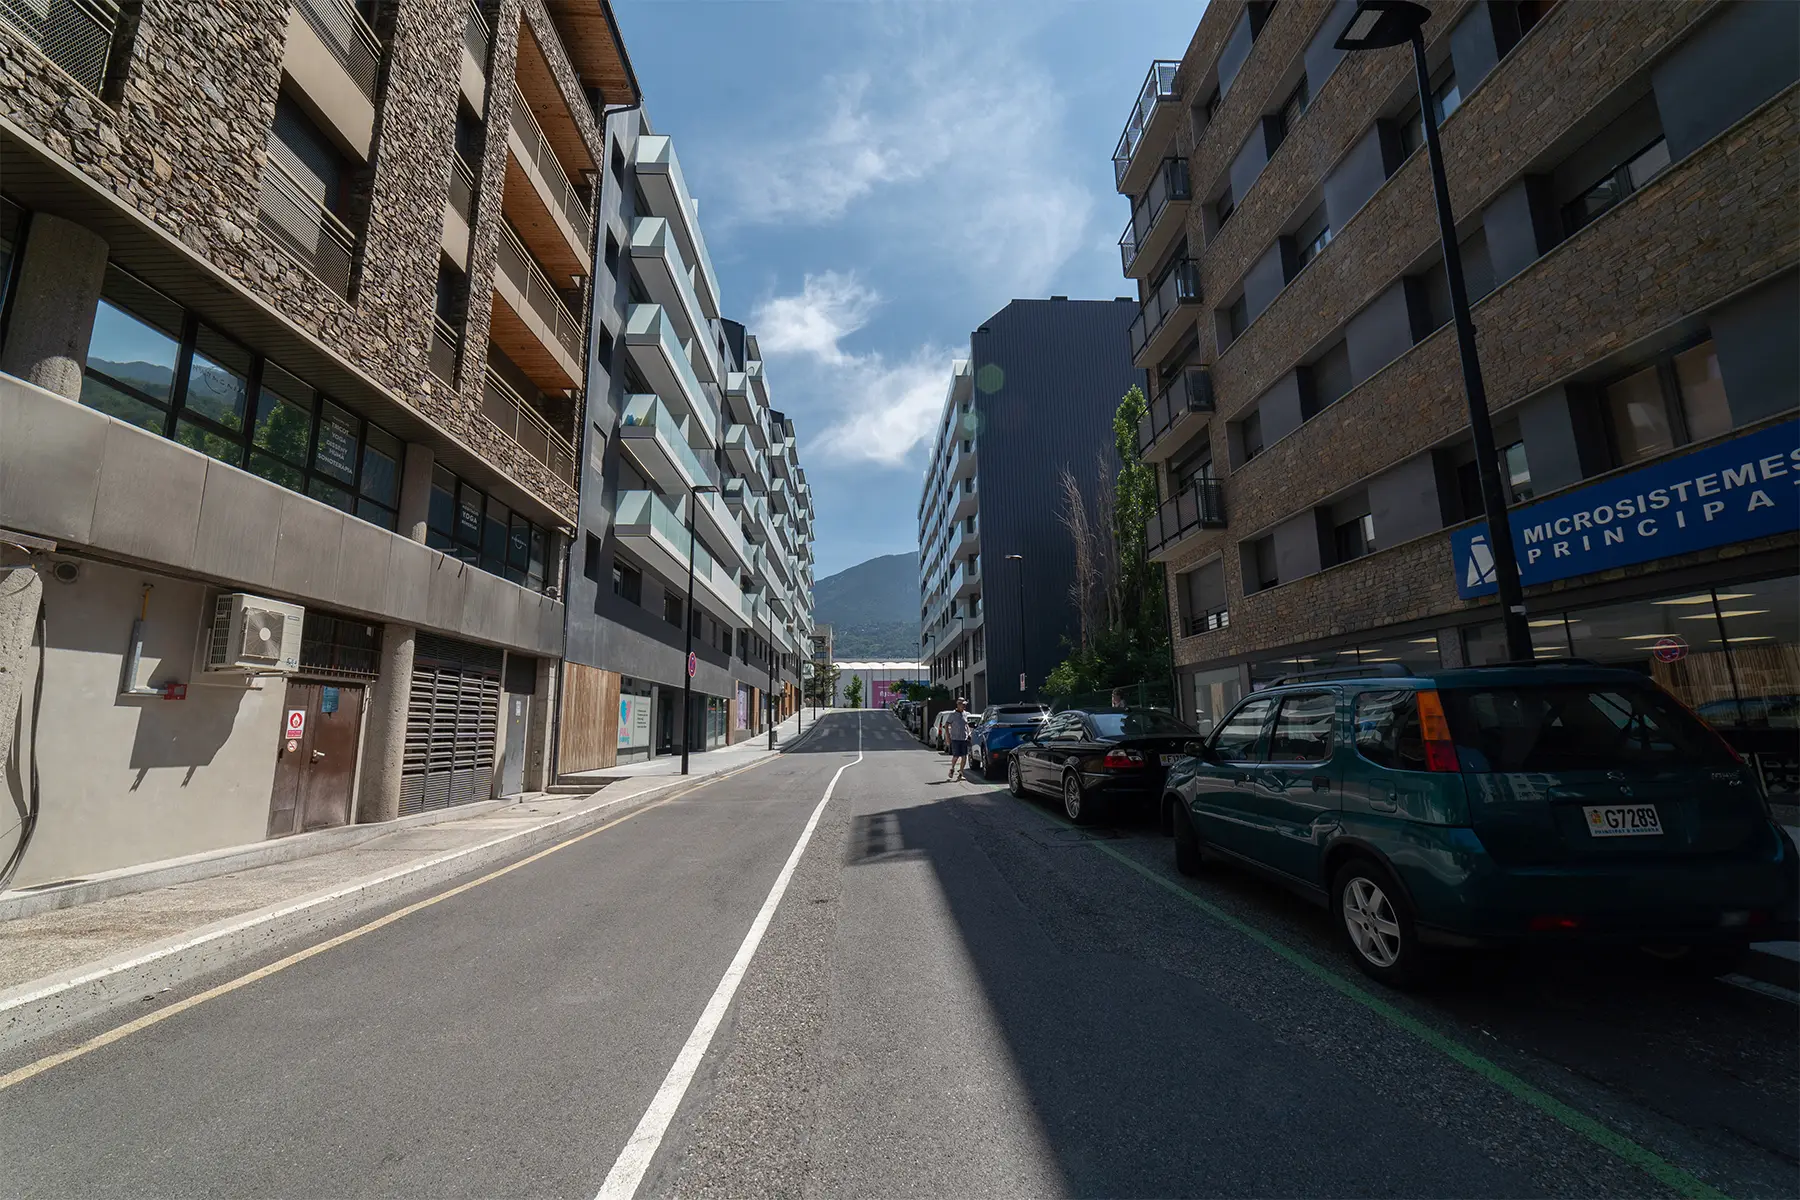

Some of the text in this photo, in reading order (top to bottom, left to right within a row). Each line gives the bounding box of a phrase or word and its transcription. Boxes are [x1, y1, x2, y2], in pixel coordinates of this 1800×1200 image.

[332, 422, 350, 436] TRICOT
[332, 432, 347, 444] YOGA
[317, 453, 353, 475] SONOTERAPIA
[462, 510, 478, 524] YOGA
[1527, 480, 1800, 564] PRINCIPA
[1604, 808, 1659, 829] G7289
